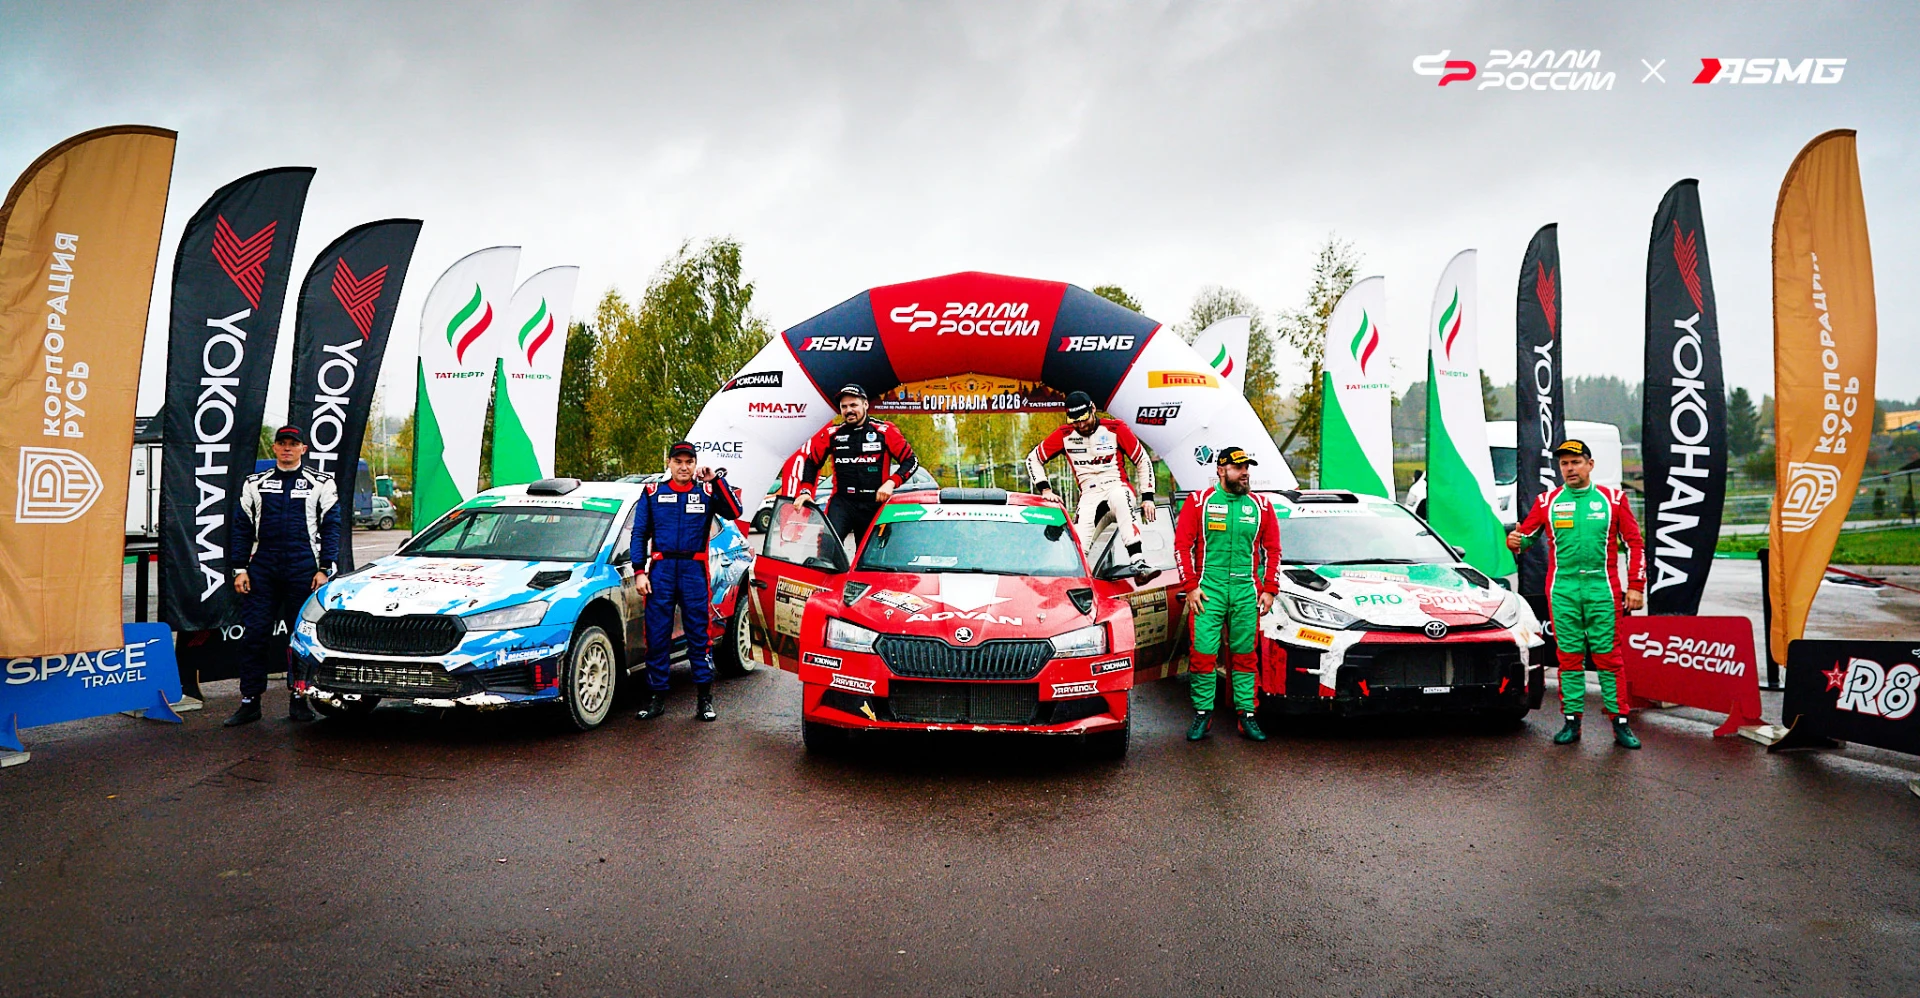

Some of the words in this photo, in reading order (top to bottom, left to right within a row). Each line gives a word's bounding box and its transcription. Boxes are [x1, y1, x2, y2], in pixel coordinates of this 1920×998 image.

[941, 302, 1030, 319] РАЛЛИ
[43, 231, 79, 437] КОРПОРАЦИЯ
[936, 318, 1041, 337] РОССИИ
[804, 336, 875, 352] ASMG
[1066, 335, 1136, 352] ASMG
[735, 374, 780, 387] YOKOHAMA
[1162, 373, 1207, 385] PIRELLI
[64, 360, 90, 438] РУСЬ
[922, 394, 988, 411] СОРТАВАЛА
[991, 393, 1021, 410] 2026
[306, 338, 364, 478] YOKOH
[1138, 406, 1178, 419] АВТО
[1835, 376, 1860, 454] РУСЬ
[1137, 417, 1166, 425] ПЛЮС
[194, 307, 252, 602] YOKOHAMA
[694, 441, 743, 453] SPACE
[1650, 311, 1709, 592] YOKOHAMA
[835, 456, 876, 464] ADVAN
[1353, 593, 1403, 607] PRO
[905, 610, 1023, 626] ADVAN
[1299, 629, 1334, 645] PIRELLI
[1666, 635, 1736, 659] РАЛЛИ
[5, 641, 147, 685] SPACE
[814, 655, 839, 667] YOKOHAMA
[1101, 660, 1128, 671] YOKOHAMA
[1663, 650, 1746, 677] РОССИИ
[81, 668, 147, 688] TRAVEL
